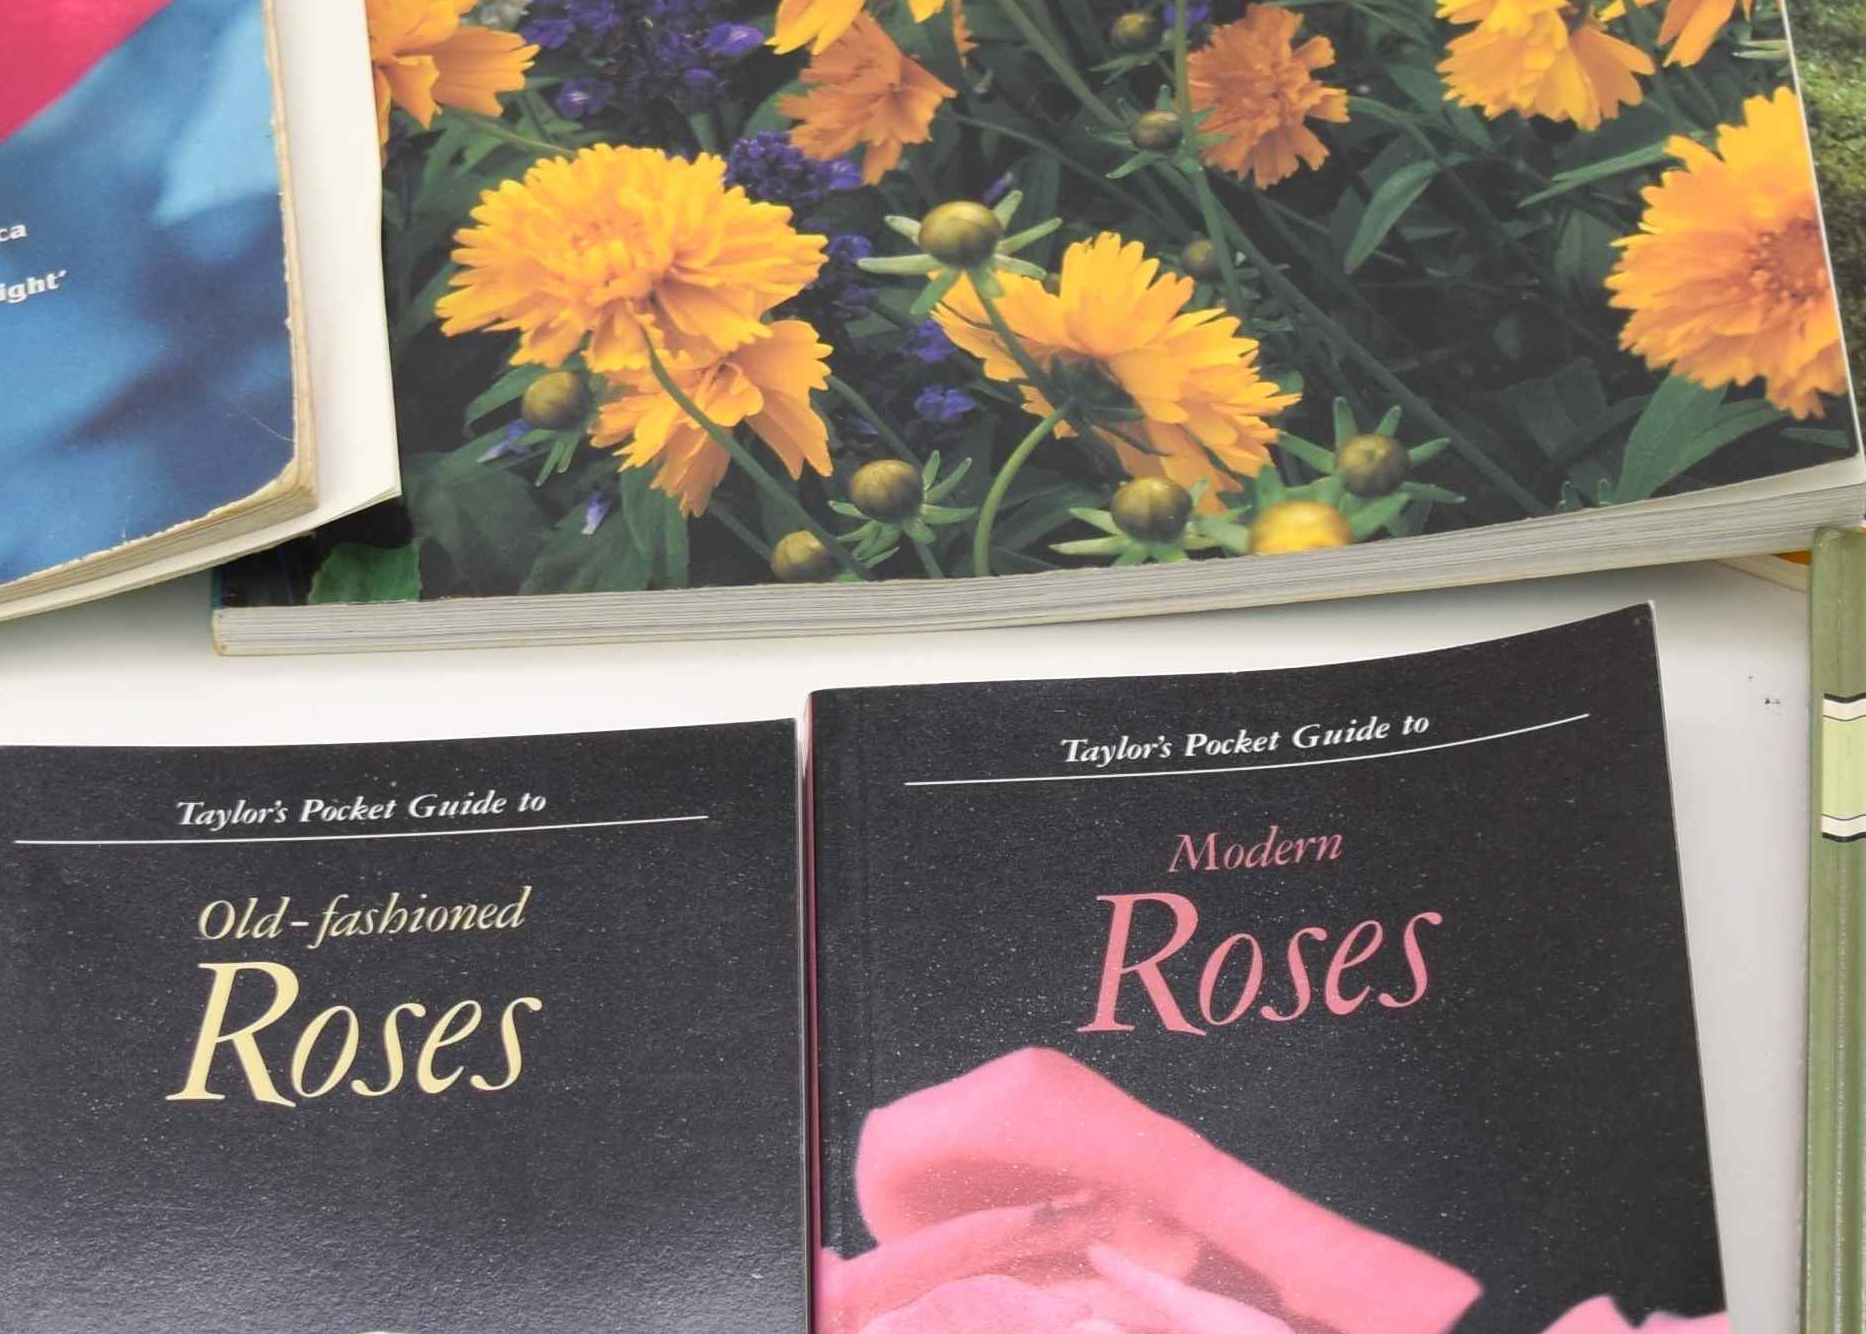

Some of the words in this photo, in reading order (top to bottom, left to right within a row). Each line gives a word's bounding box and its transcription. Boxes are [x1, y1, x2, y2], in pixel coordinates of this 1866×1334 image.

[1059, 734, 1173, 768] Taylor's
[1184, 728, 1281, 758] Pocket
[1291, 715, 1391, 750] Guide
[1402, 714, 1431, 735] to
[176, 798, 289, 833] Taylor's
[299, 795, 397, 824] Pocket
[407, 789, 508, 819] Guide
[518, 793, 547, 813] to
[1167, 824, 1344, 873] Modern
[197, 885, 533, 950] Old-fashioned
[1076, 892, 1443, 1036] Roses
[165, 961, 543, 1108] Roses
